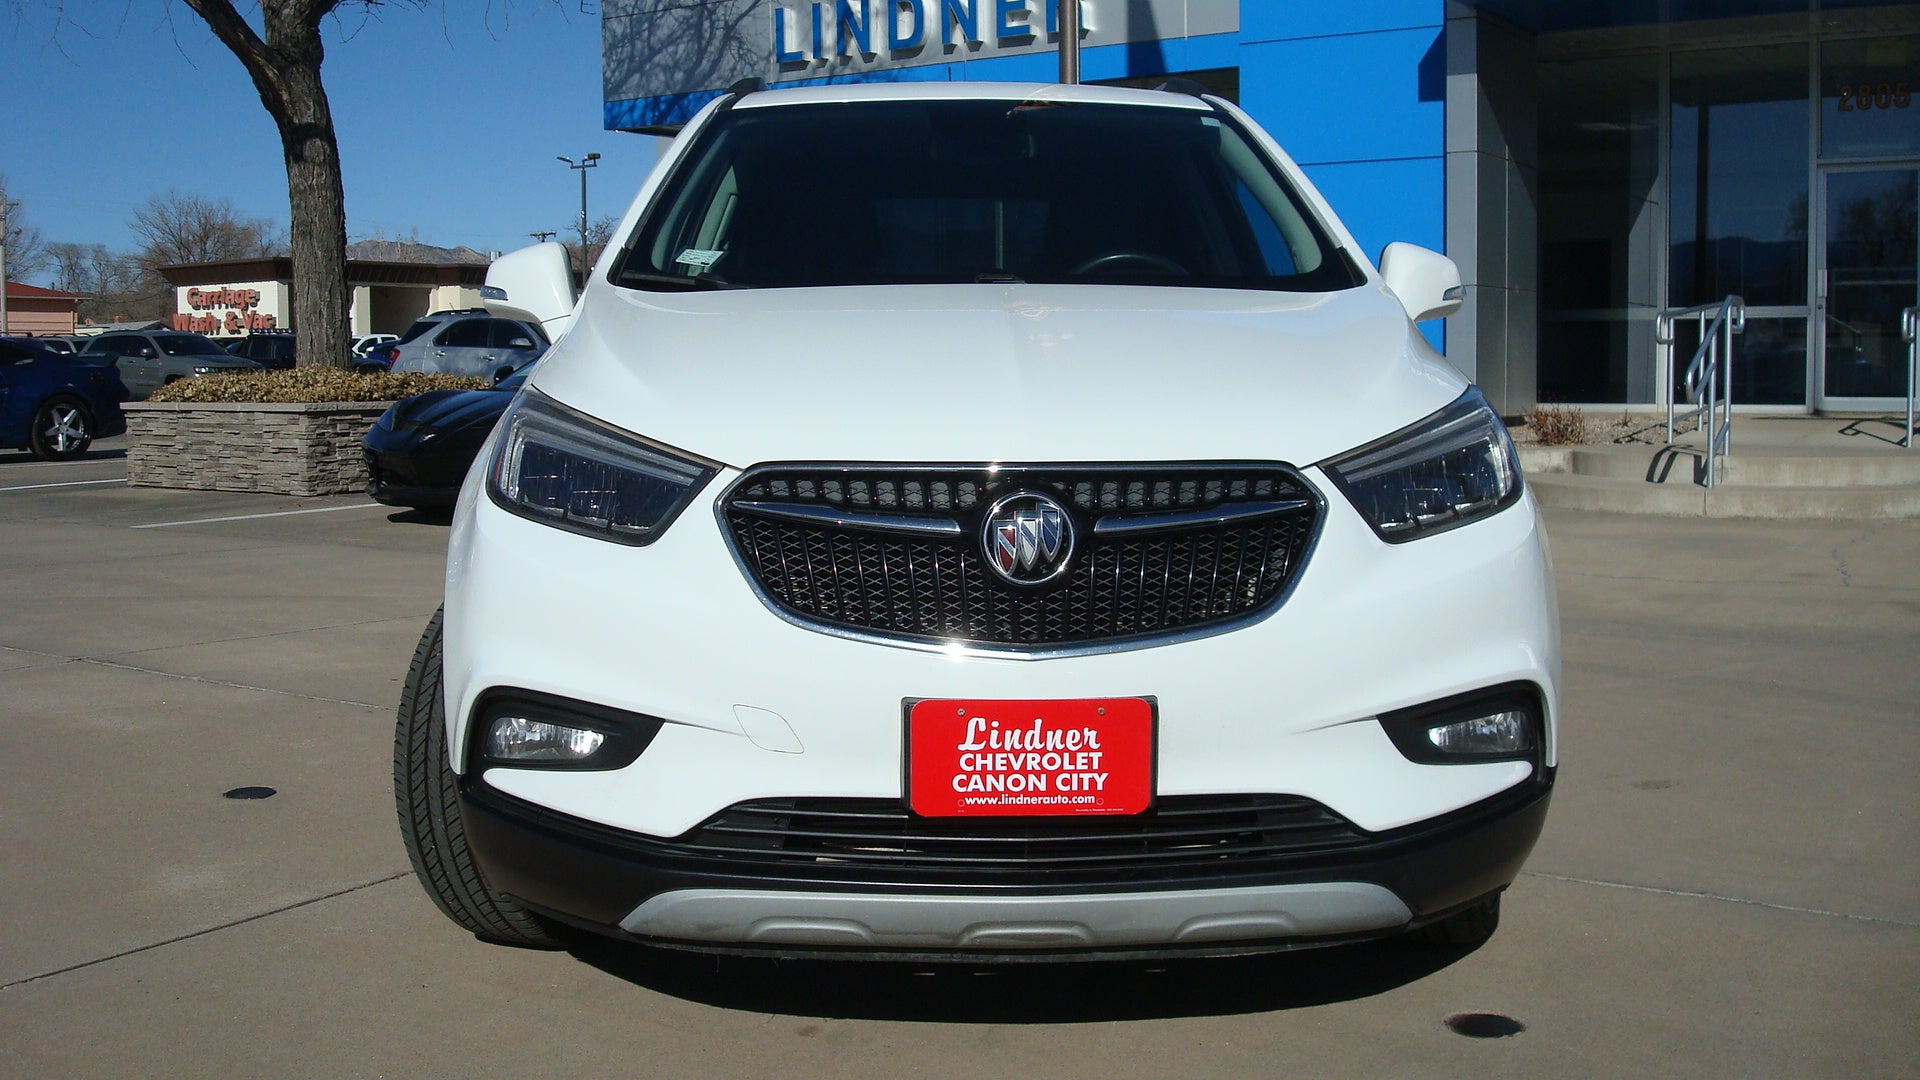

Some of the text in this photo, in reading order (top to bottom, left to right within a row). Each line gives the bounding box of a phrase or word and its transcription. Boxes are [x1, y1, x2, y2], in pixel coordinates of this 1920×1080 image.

[1838, 81, 1910, 111] 2805
[187, 286, 257, 310] Carriage
[172, 310, 273, 332] Wash & Vac
[957, 717, 1101, 752] Lindner
[959, 752, 1103, 772] CHEVROLET
[952, 772, 1109, 793] CANON CITY
[964, 793, 1095, 805] www.lindnerauto.com
